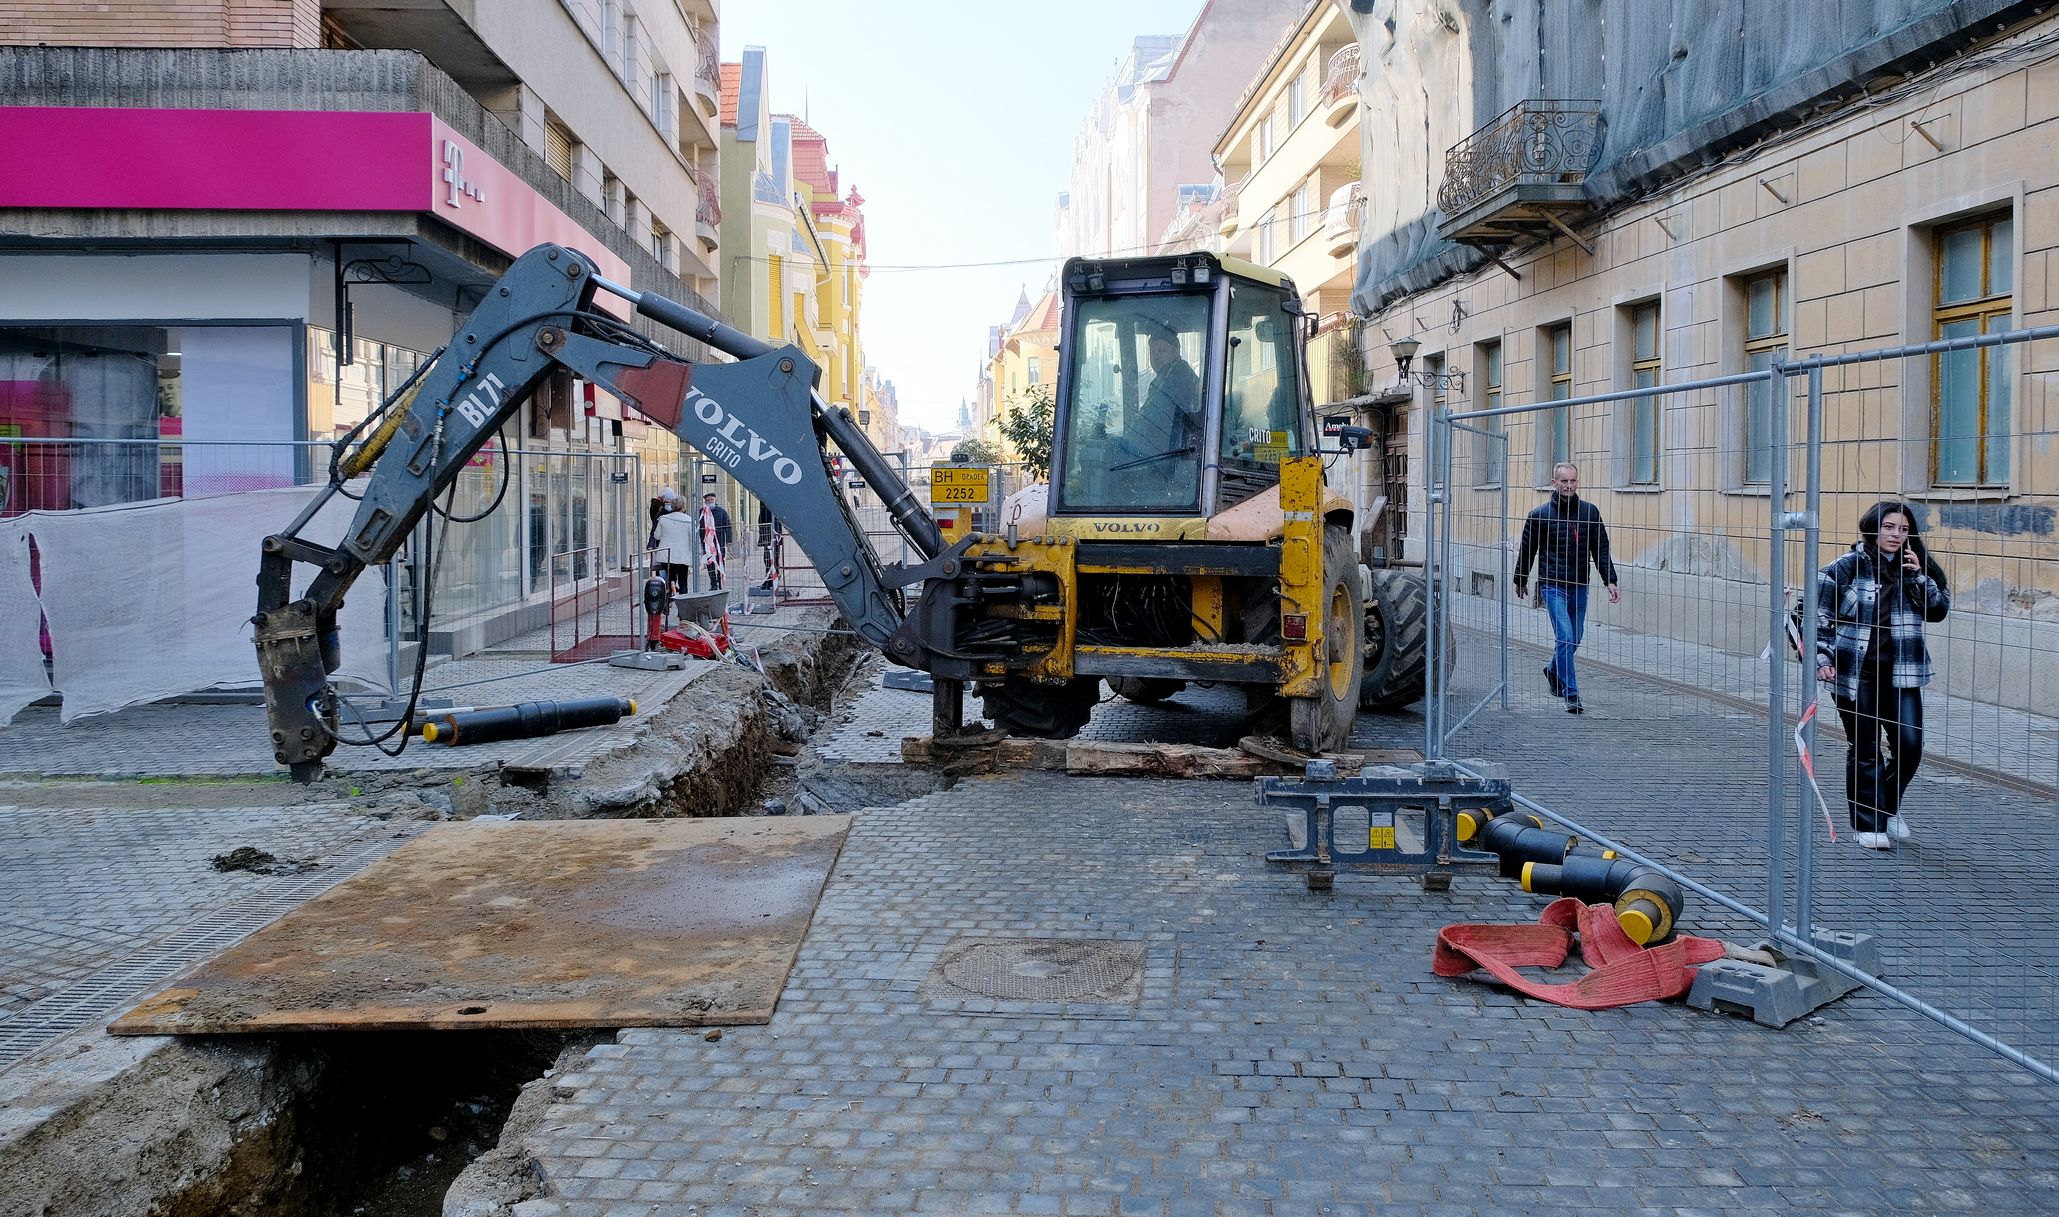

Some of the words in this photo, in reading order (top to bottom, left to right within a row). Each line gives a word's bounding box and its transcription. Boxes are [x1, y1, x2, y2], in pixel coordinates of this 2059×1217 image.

[457, 372, 506, 429] BL71
[1249, 427, 1271, 444] CRITO
[705, 436, 741, 468] CRITO
[934, 470, 953, 483] BH
[946, 487, 974, 500] 2252
[1093, 522, 1160, 533] VOLVO
